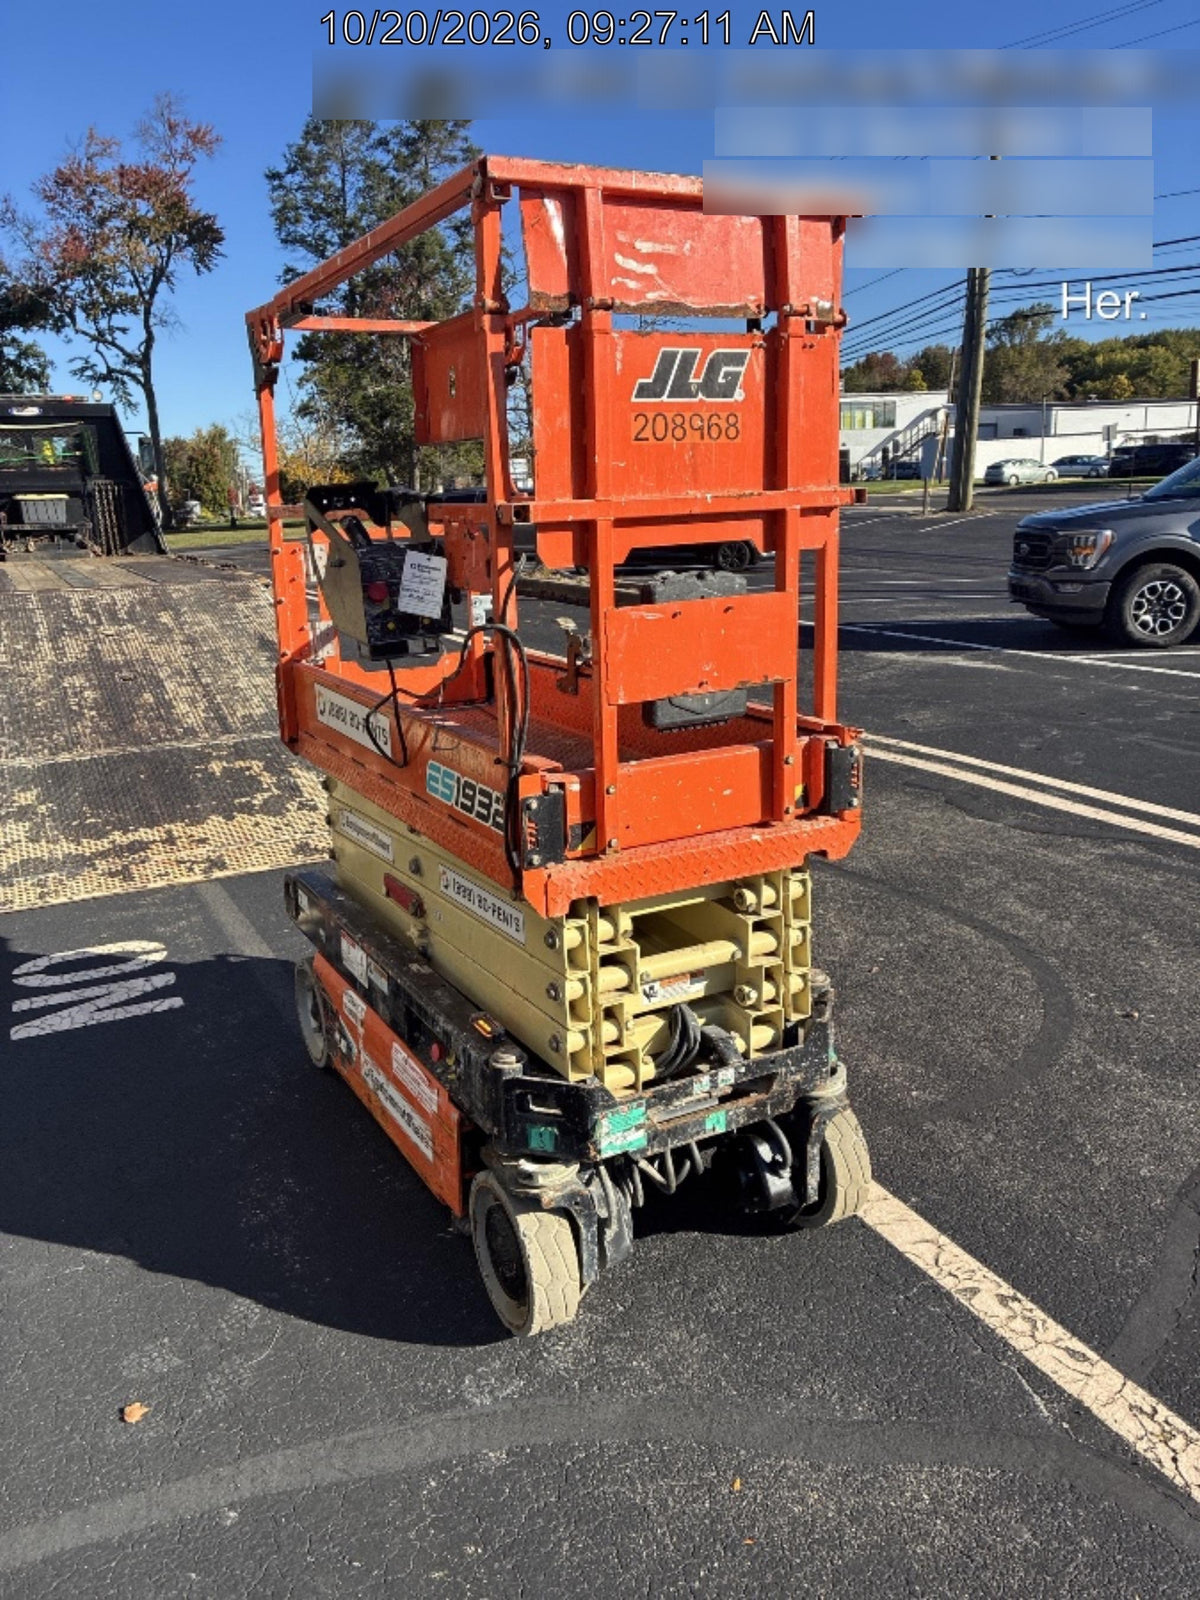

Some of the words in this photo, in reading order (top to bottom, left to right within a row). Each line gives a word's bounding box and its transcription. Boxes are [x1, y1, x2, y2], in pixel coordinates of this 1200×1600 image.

[631, 347, 752, 402] JLG
[633, 412, 741, 443] 208968
[427, 759, 505, 834] ES1932
